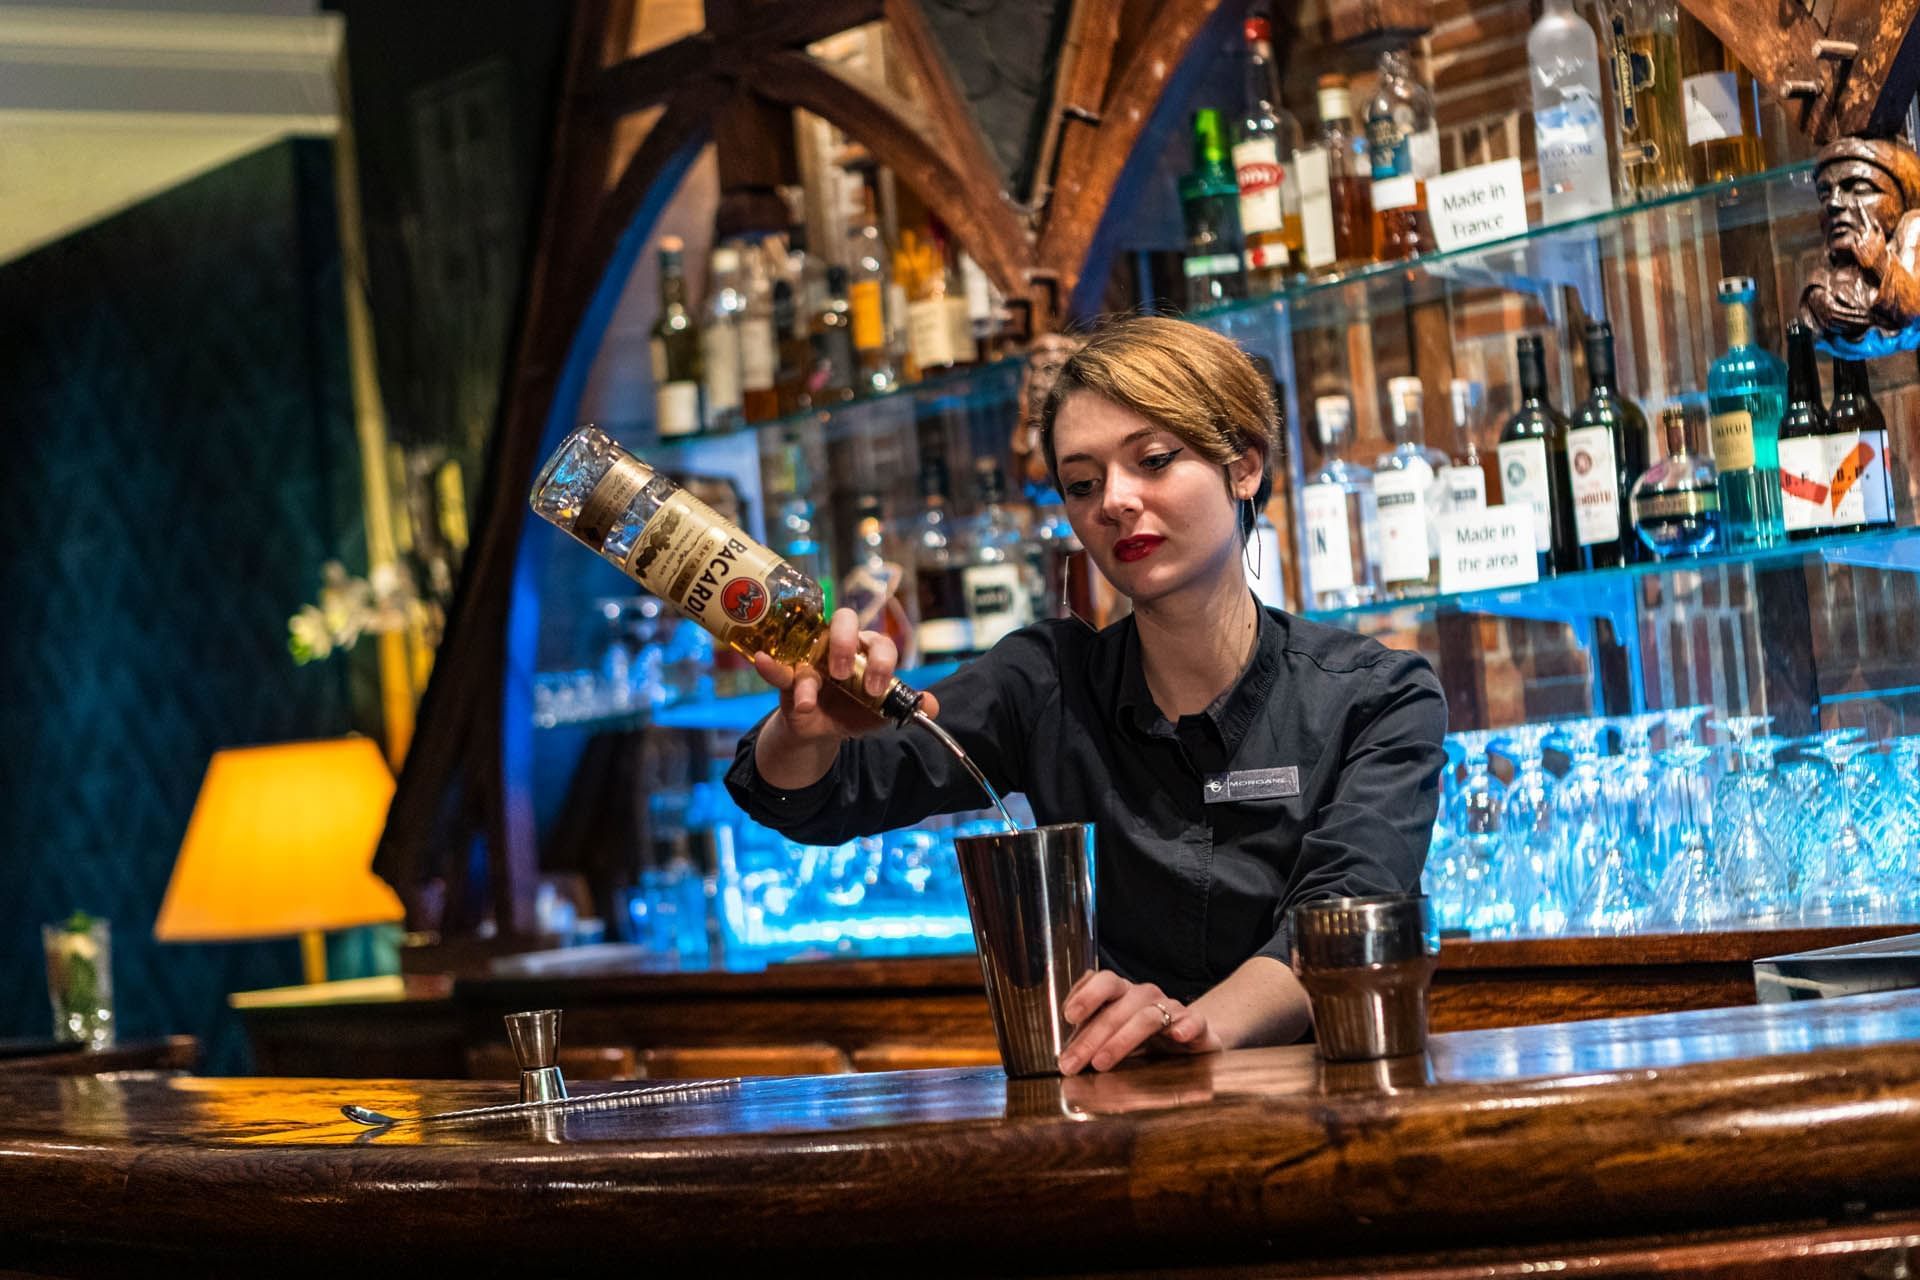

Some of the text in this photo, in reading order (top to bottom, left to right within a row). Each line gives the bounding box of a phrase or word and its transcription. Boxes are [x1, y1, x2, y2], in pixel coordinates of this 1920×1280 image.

[1442, 183, 1506, 213] Made in
[1450, 213, 1504, 239] France
[1456, 523, 1516, 544] Made in
[689, 539, 714, 570] CARTA
[1458, 553, 1519, 572] the area
